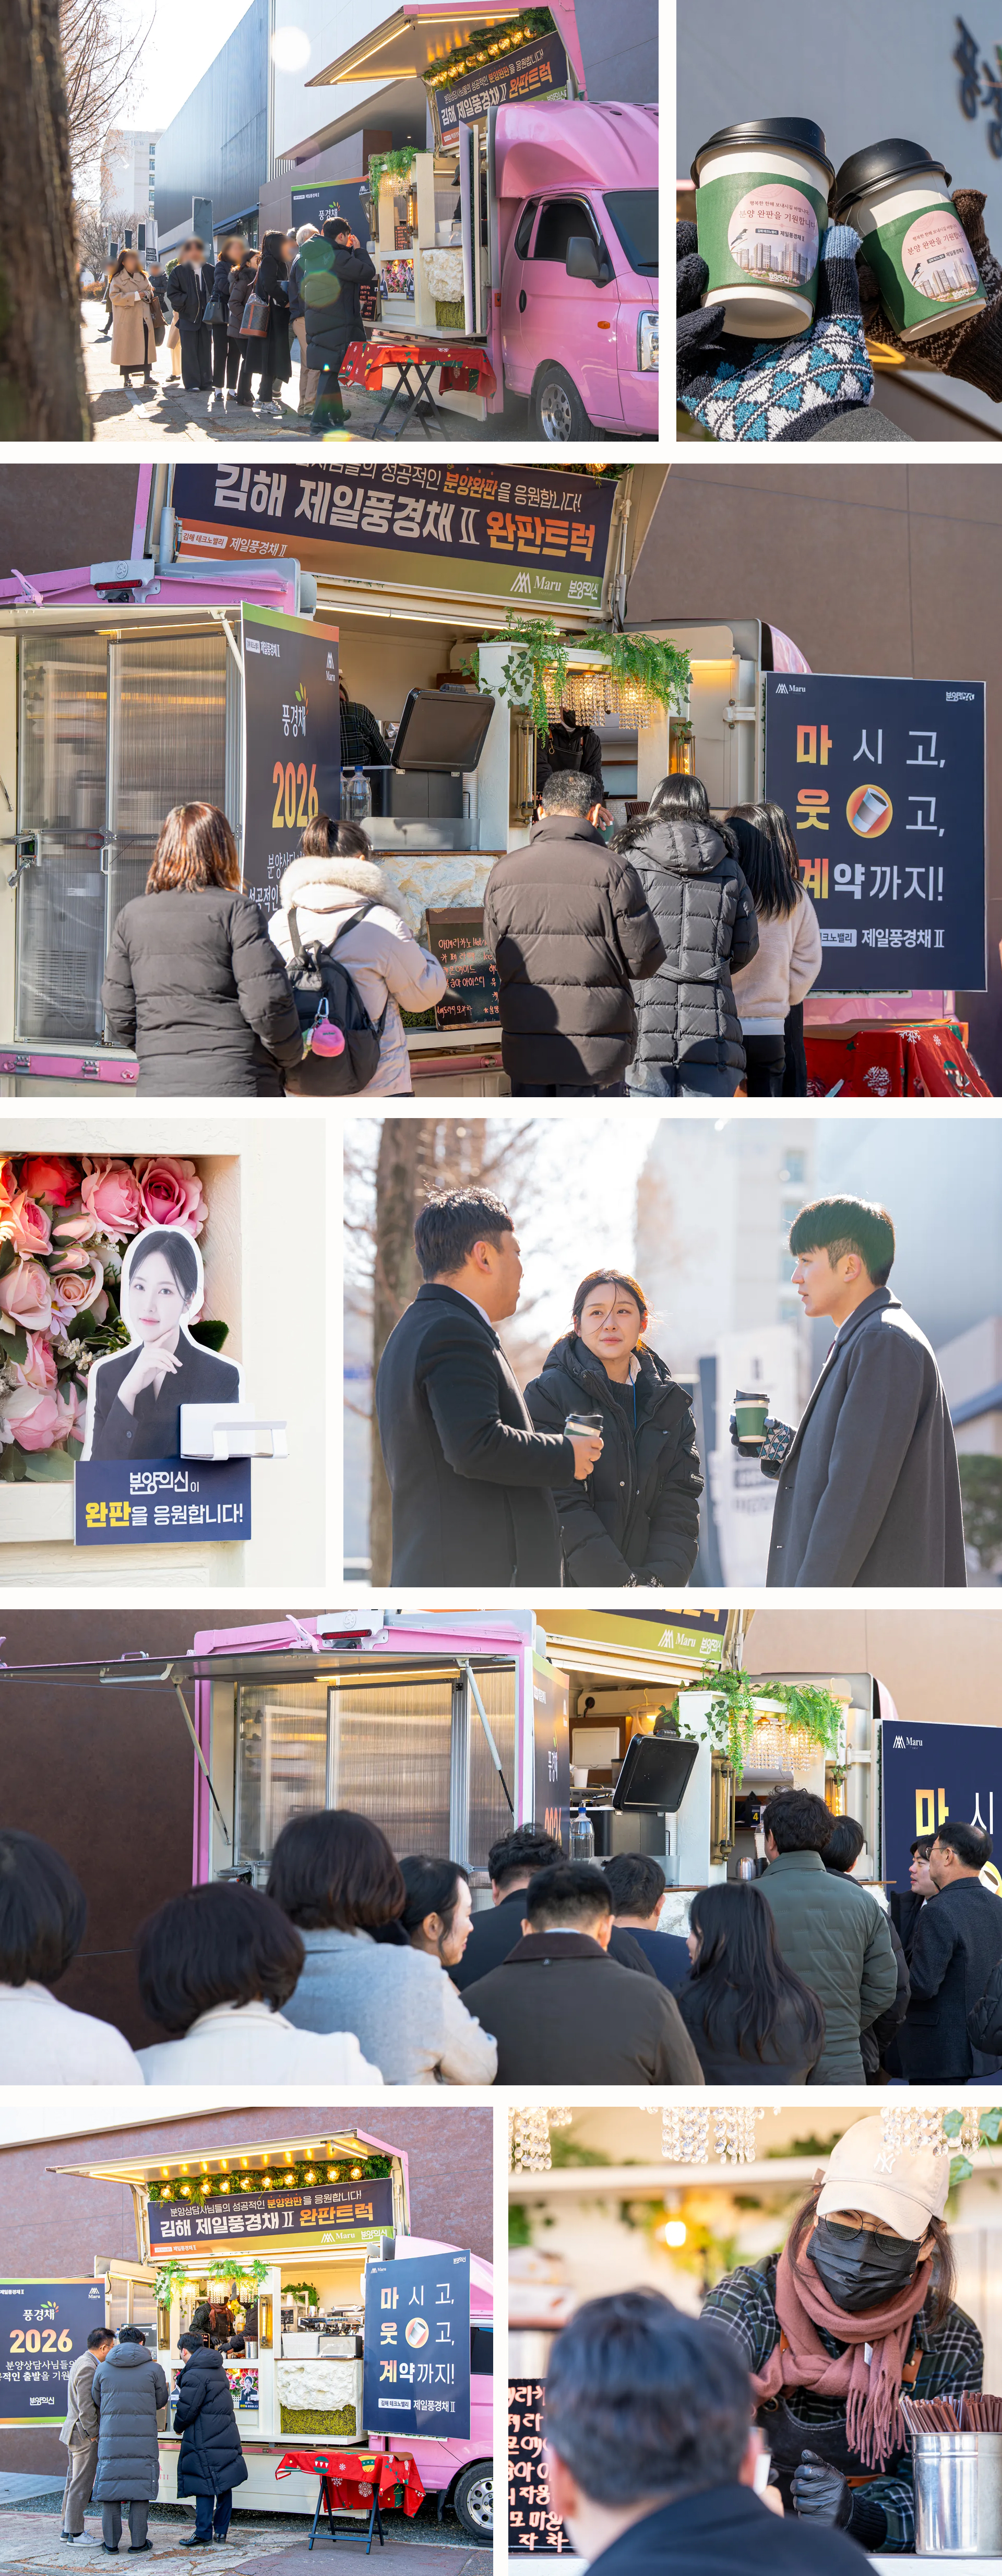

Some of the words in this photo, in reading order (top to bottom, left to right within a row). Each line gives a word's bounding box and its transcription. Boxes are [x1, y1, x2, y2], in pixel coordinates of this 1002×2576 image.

[444, 85, 471, 103] 분양상담사님들의
[471, 76, 488, 91] 성공적인
[488, 64, 515, 82] 분양완판을
[516, 49, 544, 72] 응원합니다!
[441, 105, 457, 126] 김해
[456, 85, 500, 119] 제일풍경채
[509, 62, 553, 99] 완판트럭
[318, 208, 339, 220] 풍경채
[739, 210, 755, 218] 분양
[757, 210, 782, 220] 완판을
[784, 213, 816, 231] 기원합니다
[780, 231, 801, 241] 제일풍경채
[933, 226, 947, 234] 보내시길
[907, 244, 921, 255] 분양
[922, 237, 942, 250] 완판을
[769, 274, 790, 283] 분양의신
[381, 464, 441, 491] 성공적인
[443, 471, 511, 503] 분양완판을
[514, 484, 582, 513] 응원합니다!
[214, 464, 287, 517] 김해
[294, 479, 455, 542] 제일풍경채
[486, 511, 595, 562] 완판트럭
[183, 532, 195, 542] 김해
[196, 534, 224, 547] 테크노밸리
[229, 538, 278, 556] 제일풍경채
[533, 575, 562, 591] Maru
[567, 580, 599, 600] 분양의신
[326, 670, 336, 682] Maru
[282, 703, 307, 737] 풍경채
[272, 761, 319, 829] 2026
[438, 937, 472, 950] 아메리카노
[820, 932, 852, 944] 크노밸리
[862, 928, 932, 948] 제일풍경채
[462, 976, 485, 988] 아이스티
[85, 1501, 148, 1528] 완판을
[153, 1503, 243, 1526] 응원합니다!
[675, 1633, 696, 1647] Maru
[906, 1737, 923, 1746] Maru
[548, 1751, 558, 1782] 풍경채
[170, 2203, 231, 2217] 분양상담사님들의
[232, 2200, 265, 2212] 성공적인
[267, 2195, 312, 2209] 분양완판을
[314, 2190, 362, 2204] 응원합니다!
[160, 2218, 191, 2238] 김해
[196, 2212, 279, 2235] 제일풍경채
[300, 2202, 373, 2226] 완판트럭
[22, 2309, 55, 2321] 풍경채
[9, 2329, 73, 2353] 2026
[0, 2371, 20, 2382] 적인
[22, 2371, 50, 2381] 출발을
[379, 2360, 454, 2384] 계약까지!
[30, 2396, 55, 2406] 분양의신
[413, 2399, 449, 2412] 제일풍경채
